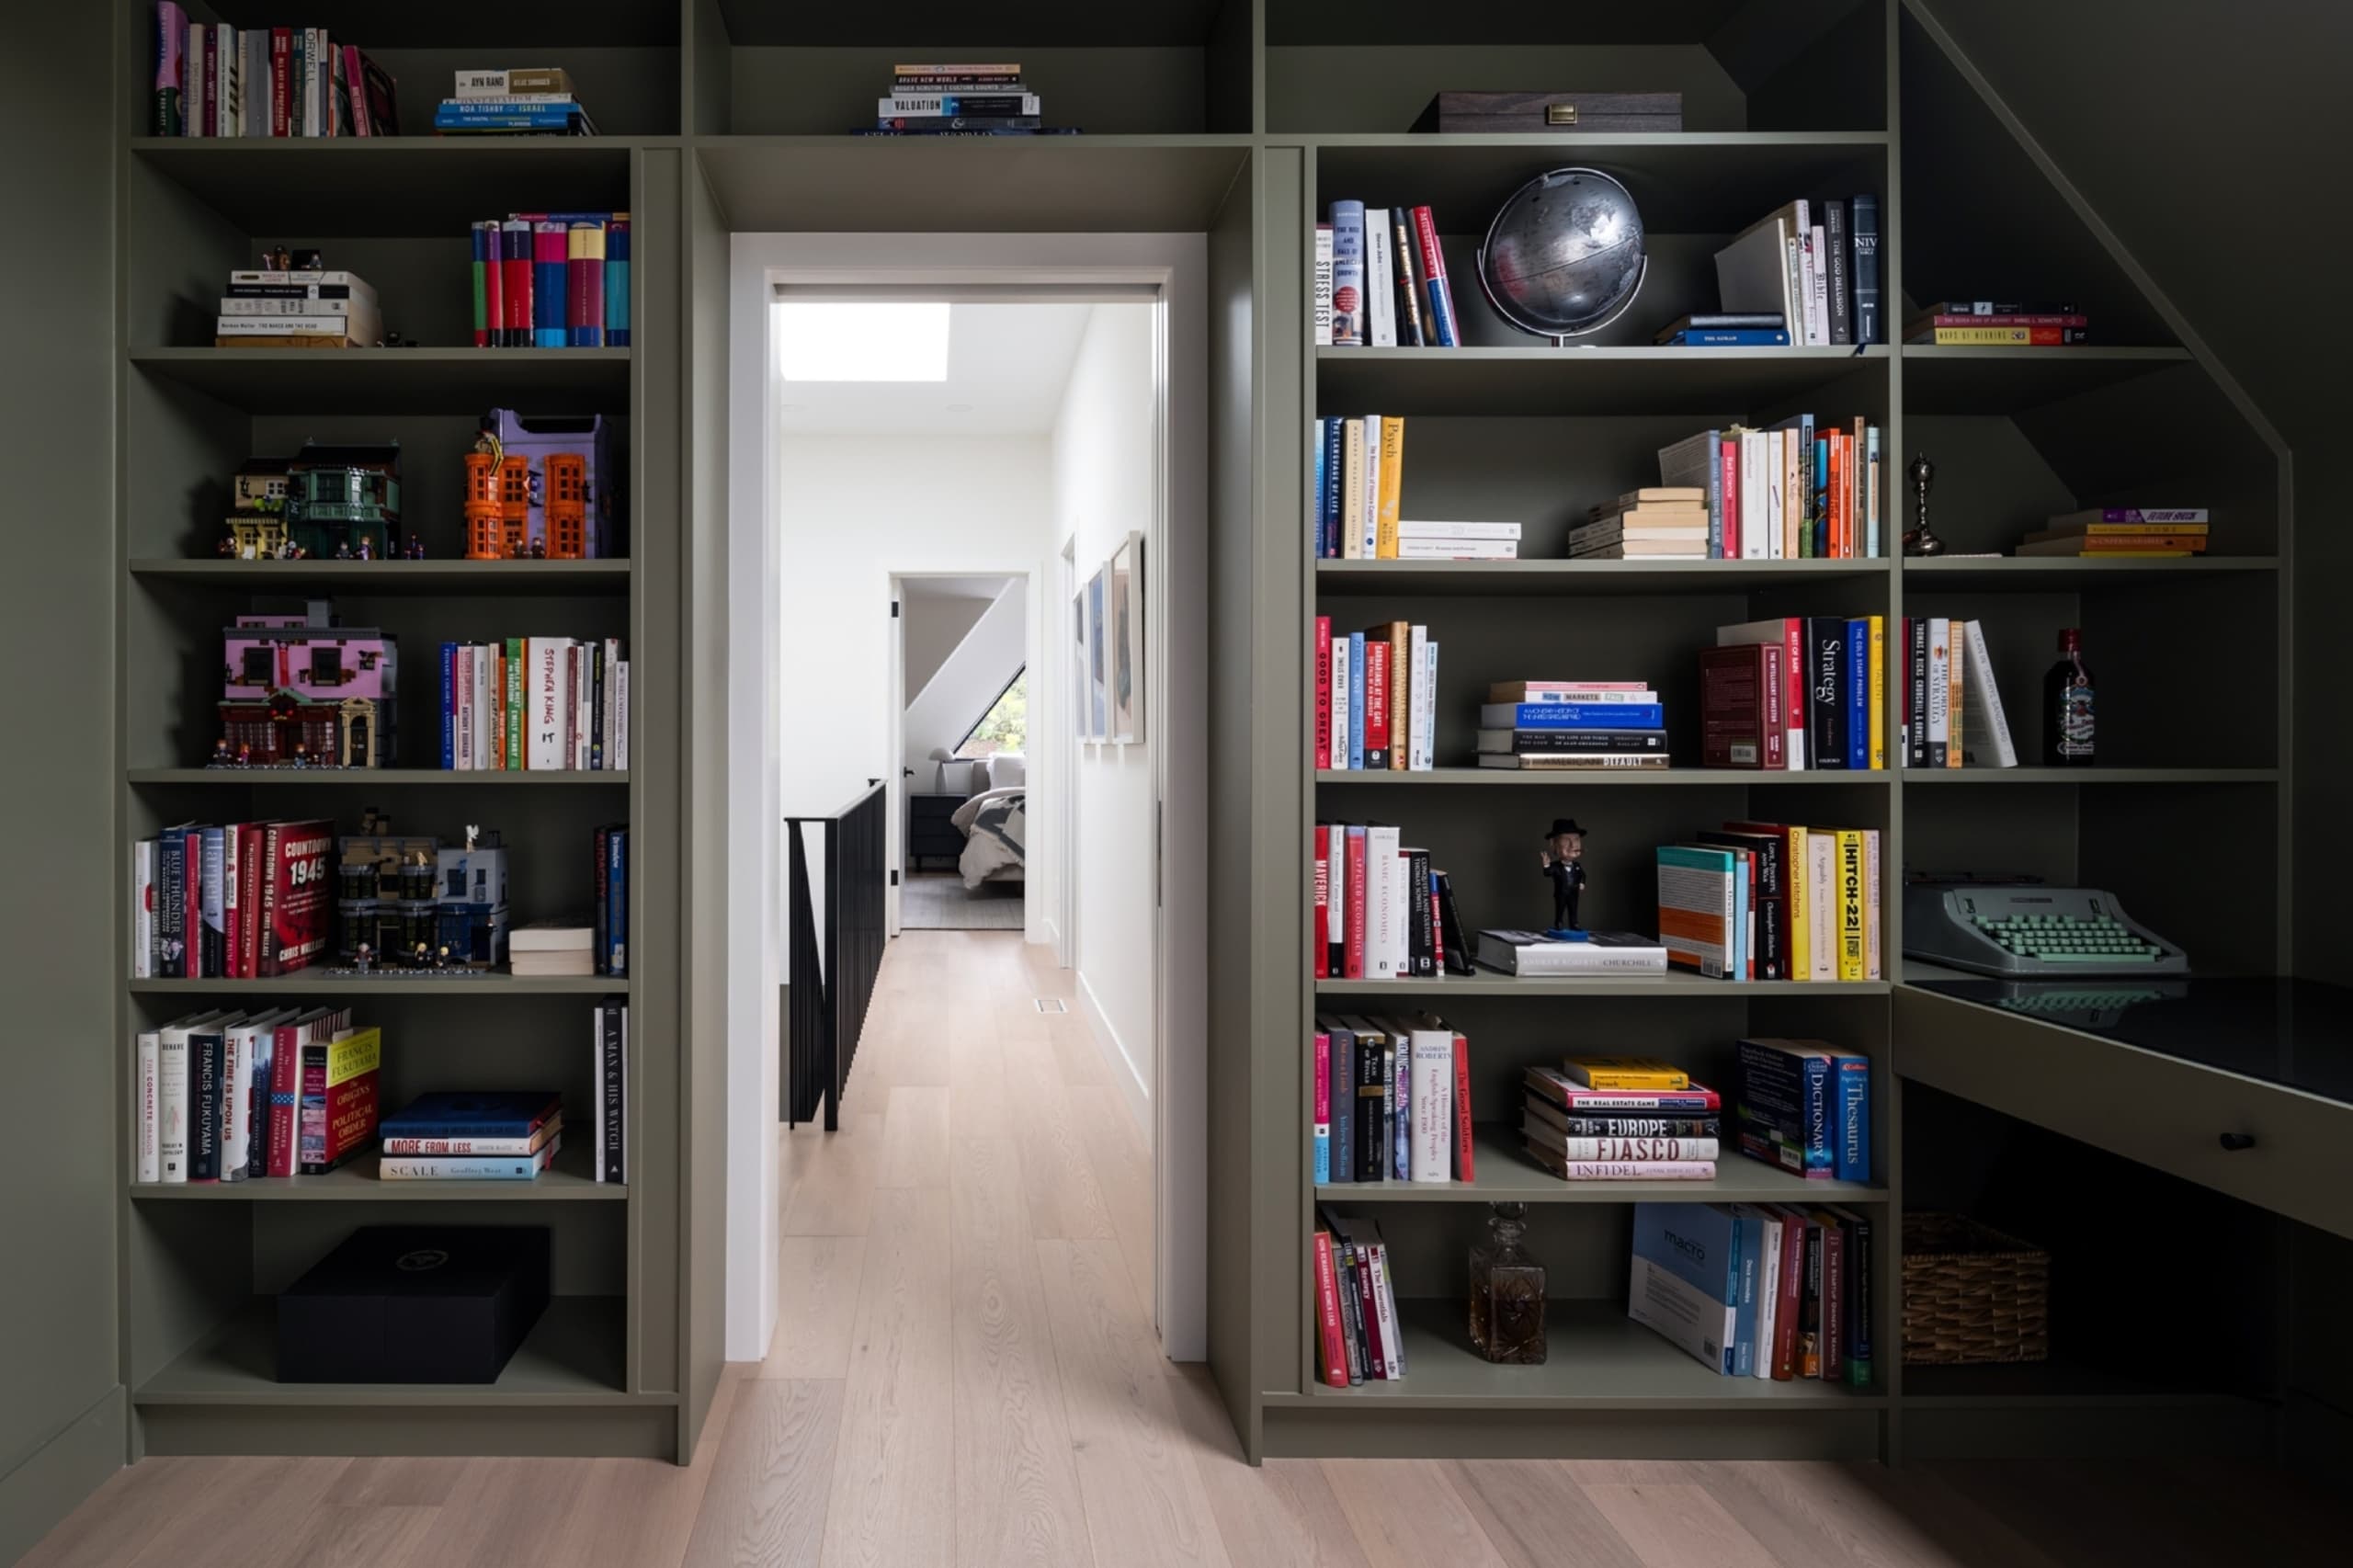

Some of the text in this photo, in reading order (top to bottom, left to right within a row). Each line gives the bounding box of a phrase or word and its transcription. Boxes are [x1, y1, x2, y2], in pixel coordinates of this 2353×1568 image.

[307, 32, 316, 81] ORWELL
[472, 76, 504, 86] AYN RAND
[895, 99, 941, 110] VALUATION
[1855, 237, 1877, 248] NIV
[1316, 261, 1330, 327] STRESS TEST
[1836, 277, 1845, 316] DELUSION
[1383, 424, 1399, 459] Psych
[1374, 645, 1382, 686] BARBARIANS
[1816, 640, 1840, 706] Strategy
[543, 648, 555, 724] STEPHEN KING
[1318, 653, 1326, 751] GOOD TO GREAT
[1373, 711, 1381, 727] GATE
[1374, 698, 1382, 709] THE
[1992, 700, 2006, 743] SANDBERG
[202, 835, 223, 903] Harper
[266, 829, 277, 881] COUNTDOWN
[290, 857, 325, 885] 1945
[596, 833, 606, 897] AUDACITY
[1314, 860, 1326, 906] MAVERICK
[1792, 831, 1802, 919] Christopher Hitchens
[1846, 849, 1858, 926] HITCH-22
[171, 850, 180, 934] BLUE THUNDER
[265, 884, 274, 907] 1945
[262, 931, 270, 957] WALLACE
[279, 945, 299, 961] CHRIS
[277, 1033, 285, 1086] EVANGELICALS
[332, 1053, 377, 1078] FUKUYAMA
[336, 1043, 373, 1063] FRANCIS
[608, 1041, 618, 1066] MAN
[1397, 1037, 1409, 1070] YOUNG
[201, 1043, 213, 1154] FRANCIS FUKUYAMA
[225, 1039, 234, 1140] THE FIRE IS UPON US
[336, 1086, 369, 1105] ORIGINS
[608, 1085, 618, 1105] HIS
[1459, 1088, 1467, 1114] Good
[332, 1104, 373, 1131] POLITICAL
[338, 1119, 367, 1138] ORDER
[608, 1108, 619, 1150] WATCH
[1608, 1119, 1667, 1136] EUROPE
[1811, 1074, 1824, 1158] DICTIONARY
[1847, 1084, 1864, 1164] Thesaurus
[392, 1140, 471, 1154] MORE FROM LESS
[1461, 1116, 1470, 1153] Soldiers
[1597, 1140, 1679, 1161] FIASCO
[391, 1165, 438, 1176] SCALE
[1576, 1165, 1640, 1176] INFIDEL
[1664, 1230, 1706, 1260] macro
[1830, 1252, 1838, 1266] THE
[1320, 1253, 1330, 1289] REMARKABLE
[1340, 1270, 1350, 1303] Titanium
[1360, 1267, 1371, 1300] Strategy
[1830, 1268, 1838, 1300] STARTUP
[1324, 1290, 1333, 1311] WOMEN
[1374, 1269, 1388, 1323] The Essentials
[1326, 1312, 1335, 1326] LEAD
[1343, 1305, 1354, 1339] Economy
[1830, 1336, 1838, 1368] MANUAL
